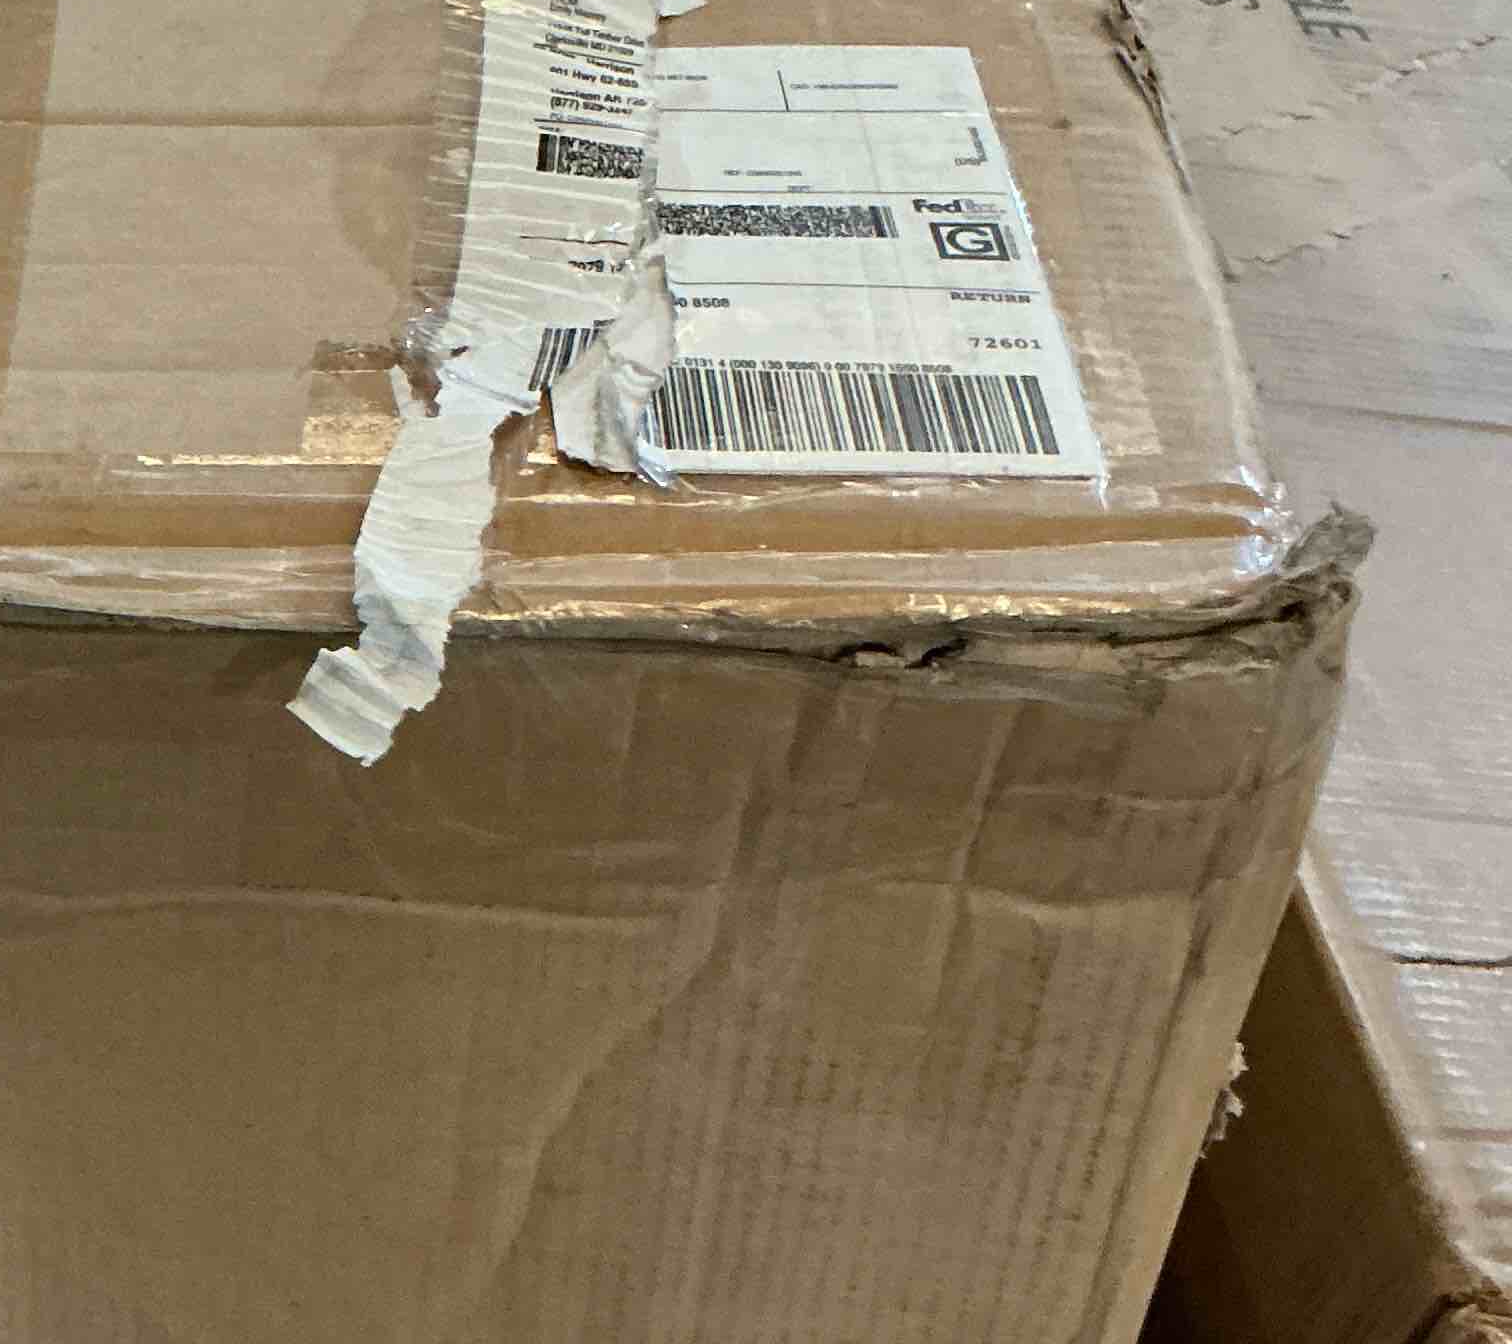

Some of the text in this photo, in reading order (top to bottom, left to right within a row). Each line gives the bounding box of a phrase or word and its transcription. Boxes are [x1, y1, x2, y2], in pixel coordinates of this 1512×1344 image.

[572, 69, 597, 83] Hwy
[946, 226, 995, 254] G
[950, 290, 1031, 304] RETURN
[967, 336, 1043, 350] 72601
